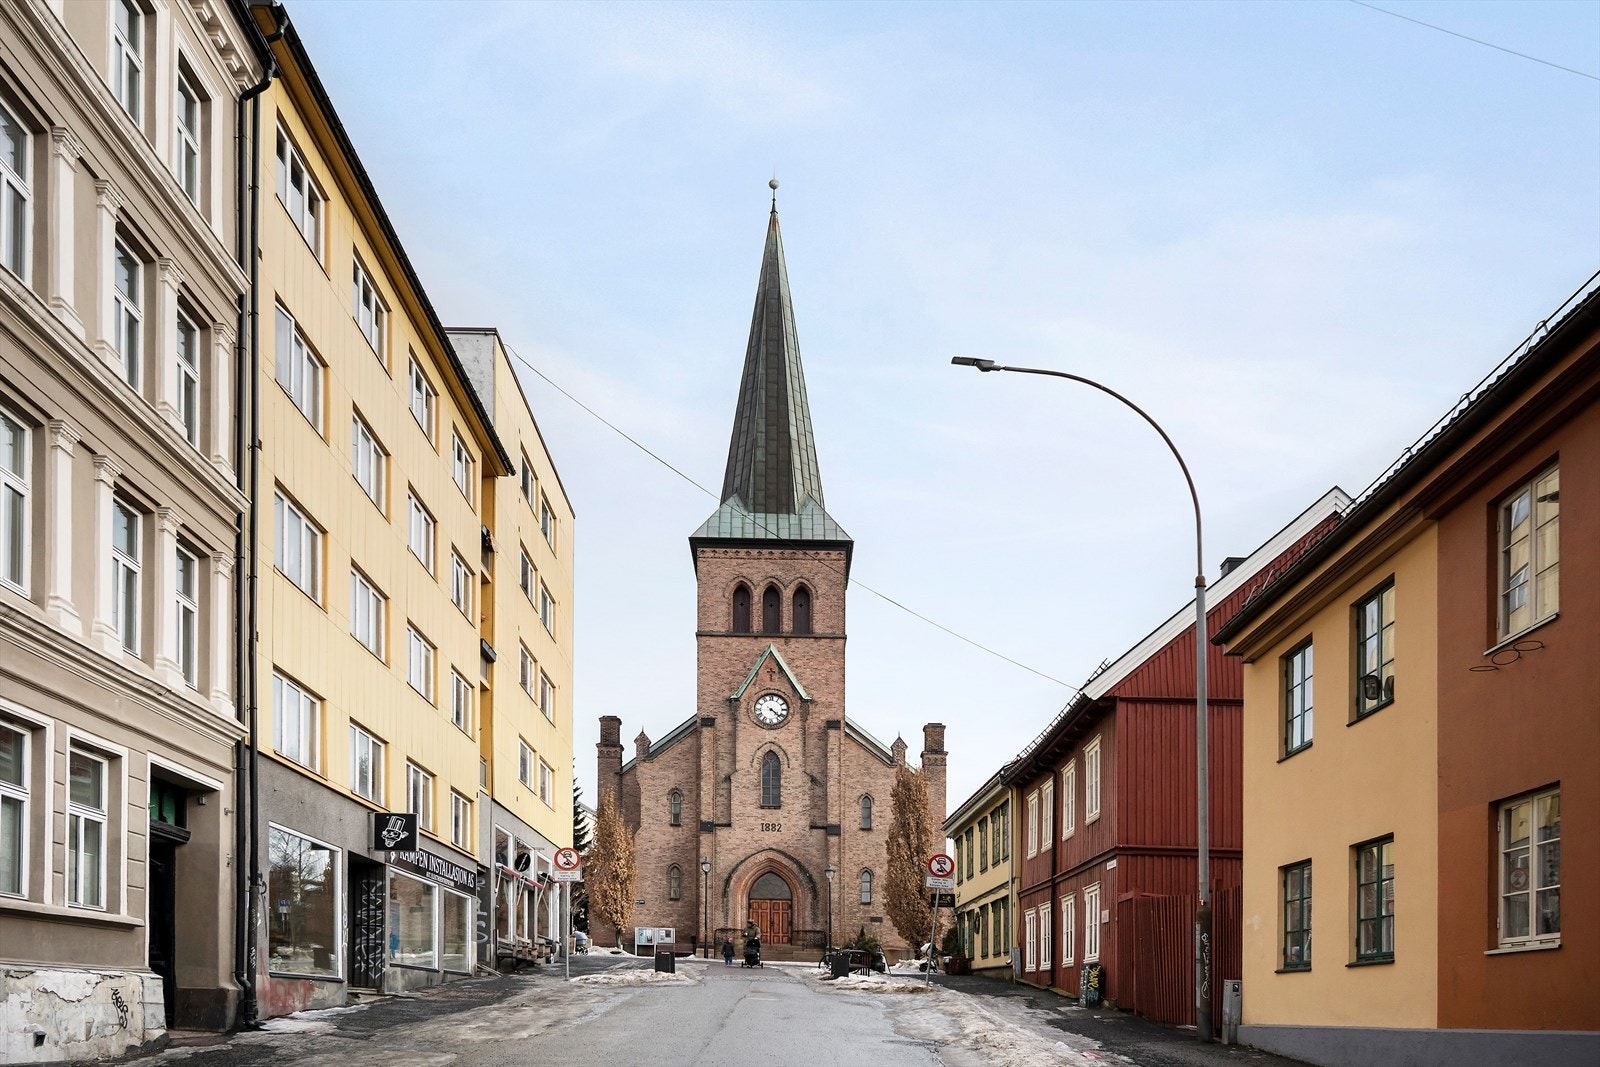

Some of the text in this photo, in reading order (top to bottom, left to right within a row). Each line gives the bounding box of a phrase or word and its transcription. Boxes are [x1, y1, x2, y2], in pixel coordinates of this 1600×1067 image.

[760, 822, 782, 832] 1882
[429, 854, 468, 886] INSTALLASJON
[467, 872, 475, 888] AS
